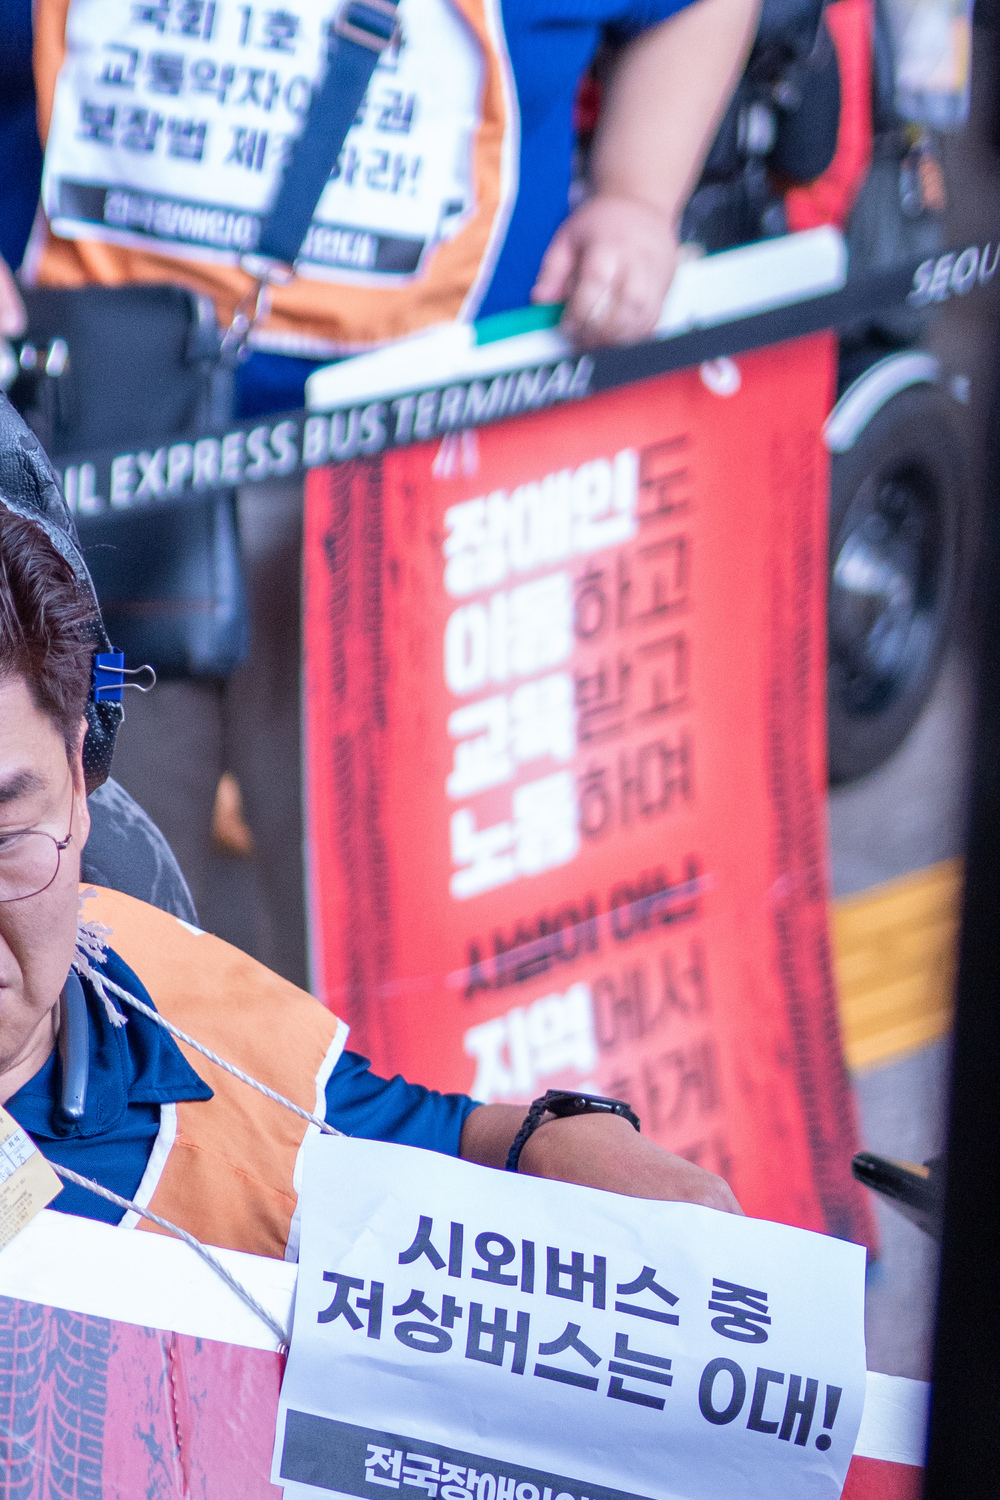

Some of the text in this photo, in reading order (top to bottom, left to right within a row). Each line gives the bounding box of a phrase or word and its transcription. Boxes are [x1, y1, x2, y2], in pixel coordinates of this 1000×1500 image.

[110, 420, 298, 508] EXPRESS
[303, 407, 386, 468] BUS
[391, 355, 596, 443] TERMINAL
[397, 1214, 772, 1345] 시외버스 중
[316, 1270, 843, 1453] 저상버스는 0대!
